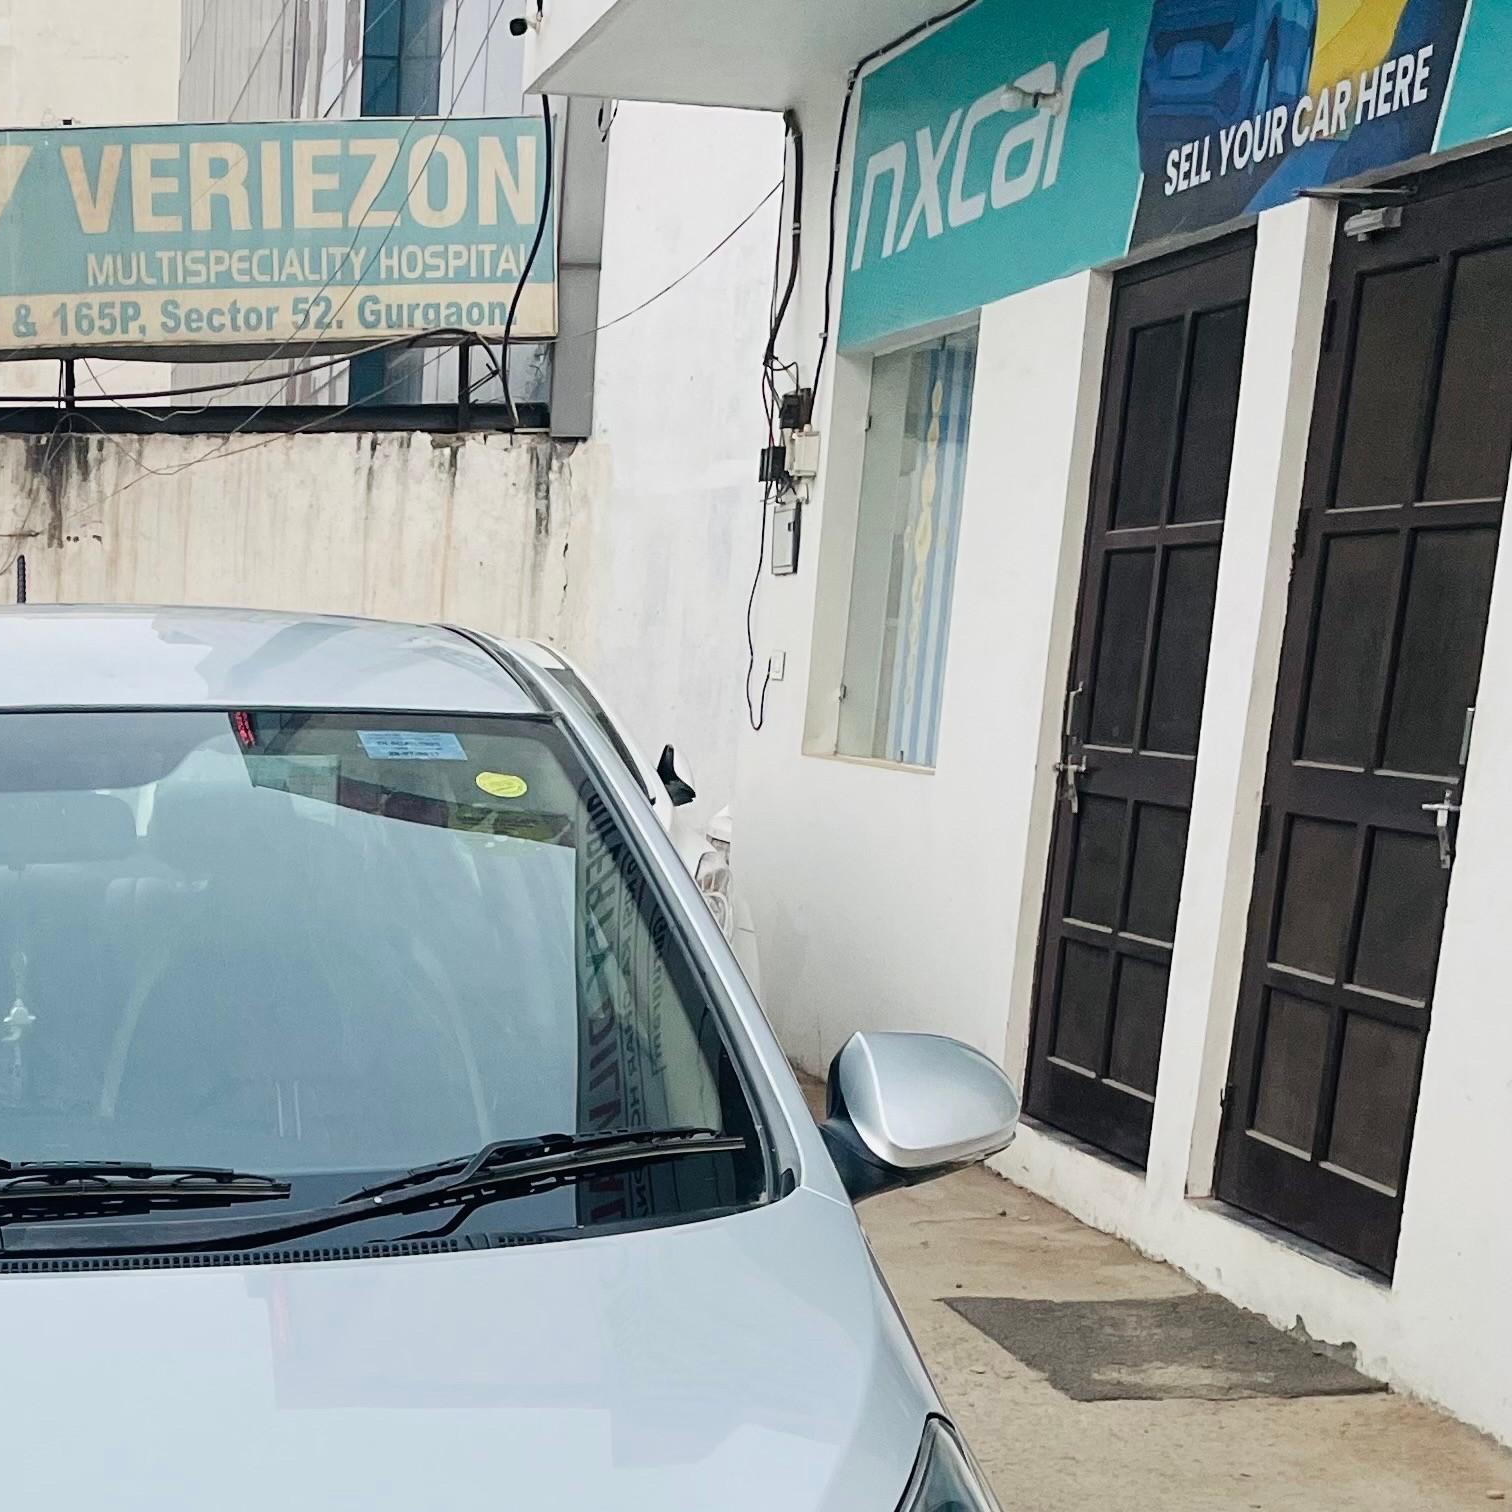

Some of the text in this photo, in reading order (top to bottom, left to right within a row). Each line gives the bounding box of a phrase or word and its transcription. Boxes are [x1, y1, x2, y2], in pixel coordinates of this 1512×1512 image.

[1164, 44, 1434, 196] SELL YOUR CAR HERE
[60, 134, 537, 234] VERIEZON
[88, 243, 534, 287] MULTISPECIALITY HOSPITAL
[12, 304, 38, 338] &
[53, 301, 146, 337] 165P,
[160, 299, 279, 333] Sector
